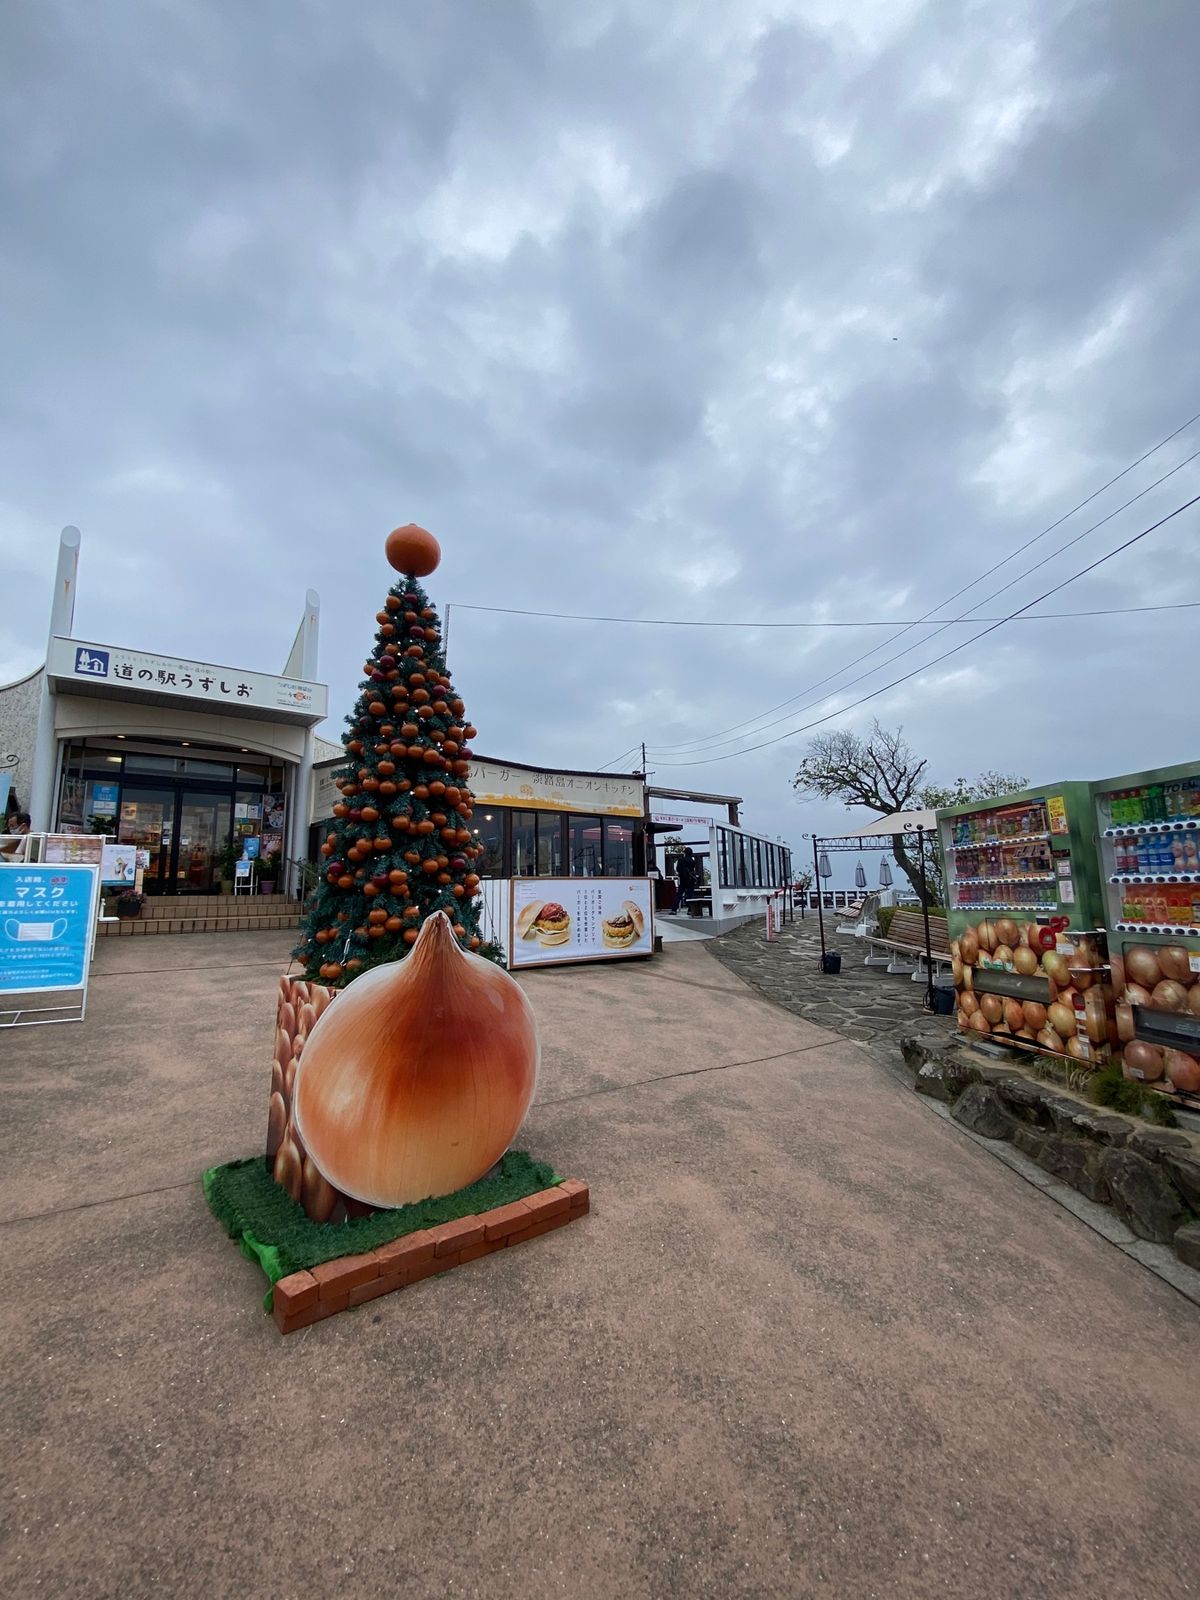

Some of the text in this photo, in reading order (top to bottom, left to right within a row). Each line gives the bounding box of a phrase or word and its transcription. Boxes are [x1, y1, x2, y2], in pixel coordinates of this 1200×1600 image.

[113, 663, 253, 698] 道の駅うずしお
[532, 772, 635, 796] 淡路島オニオンキッチン
[15, 886, 65, 899] マスク
